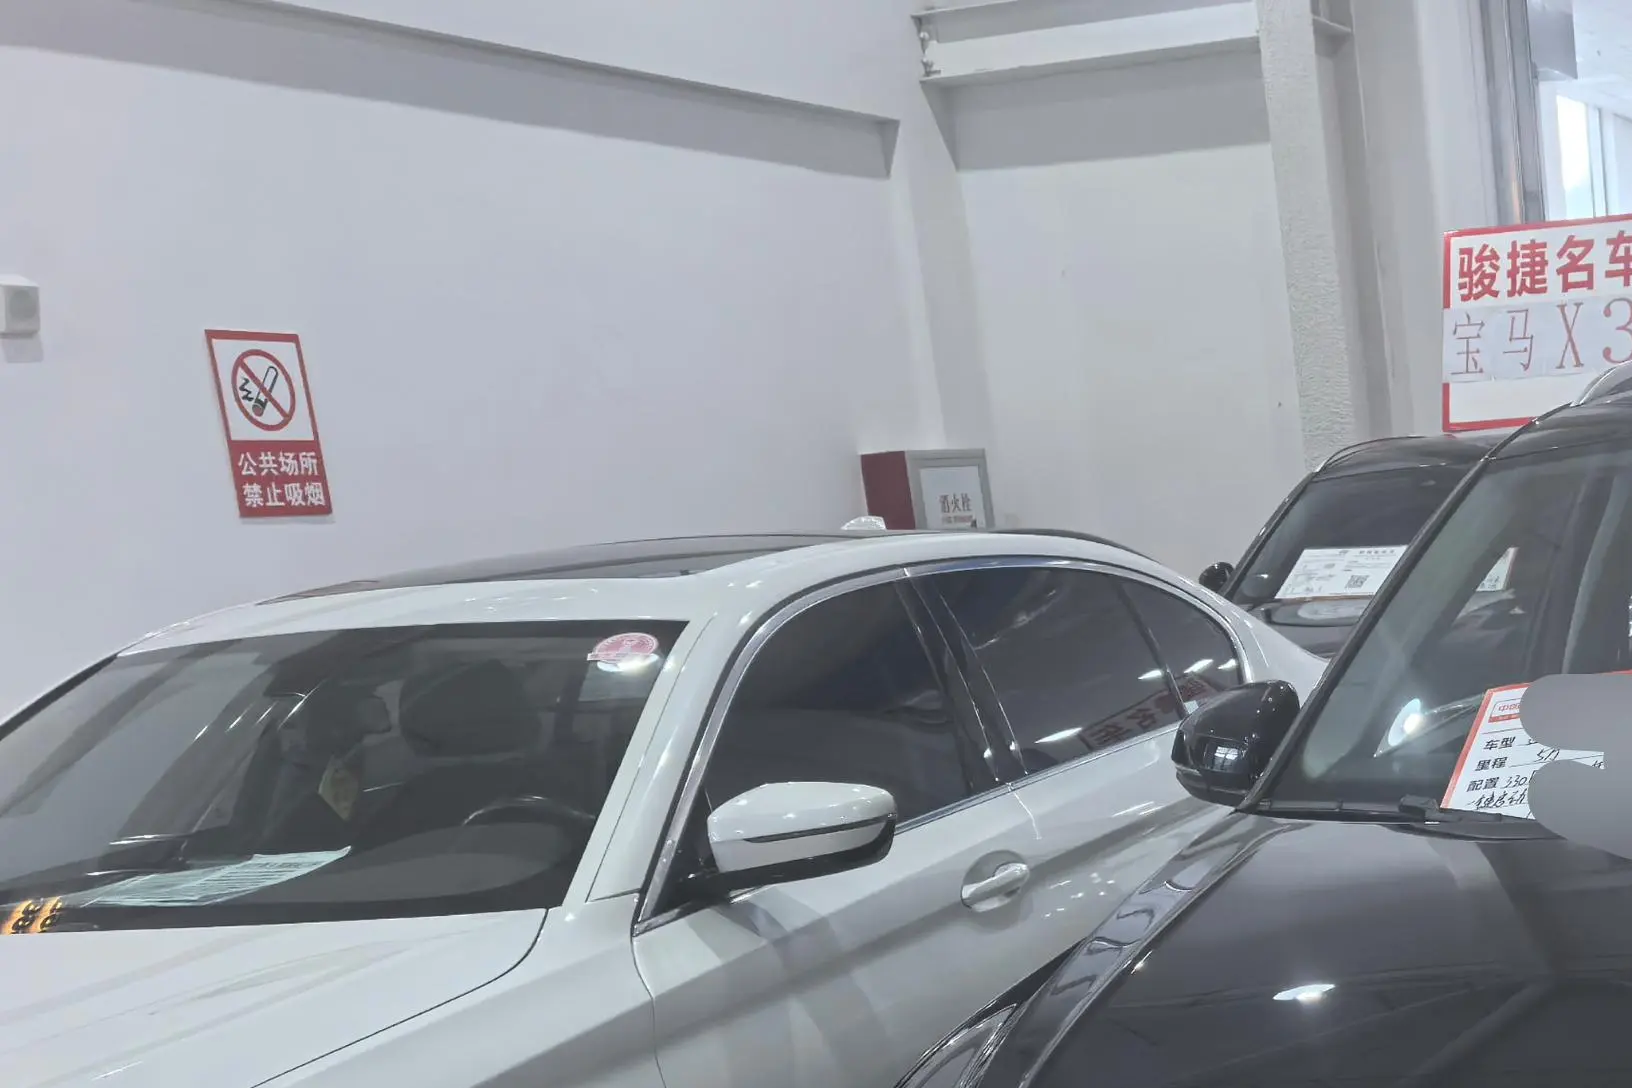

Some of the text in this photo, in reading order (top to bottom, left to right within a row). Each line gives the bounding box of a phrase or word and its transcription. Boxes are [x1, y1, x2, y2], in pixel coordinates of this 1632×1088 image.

[238, 451, 319, 476] 公共场所
[243, 482, 326, 508] 禁止吸烟
[1483, 737, 1516, 750] 车型
[1475, 757, 1508, 771] 里程
[1467, 777, 1500, 792] 配置
